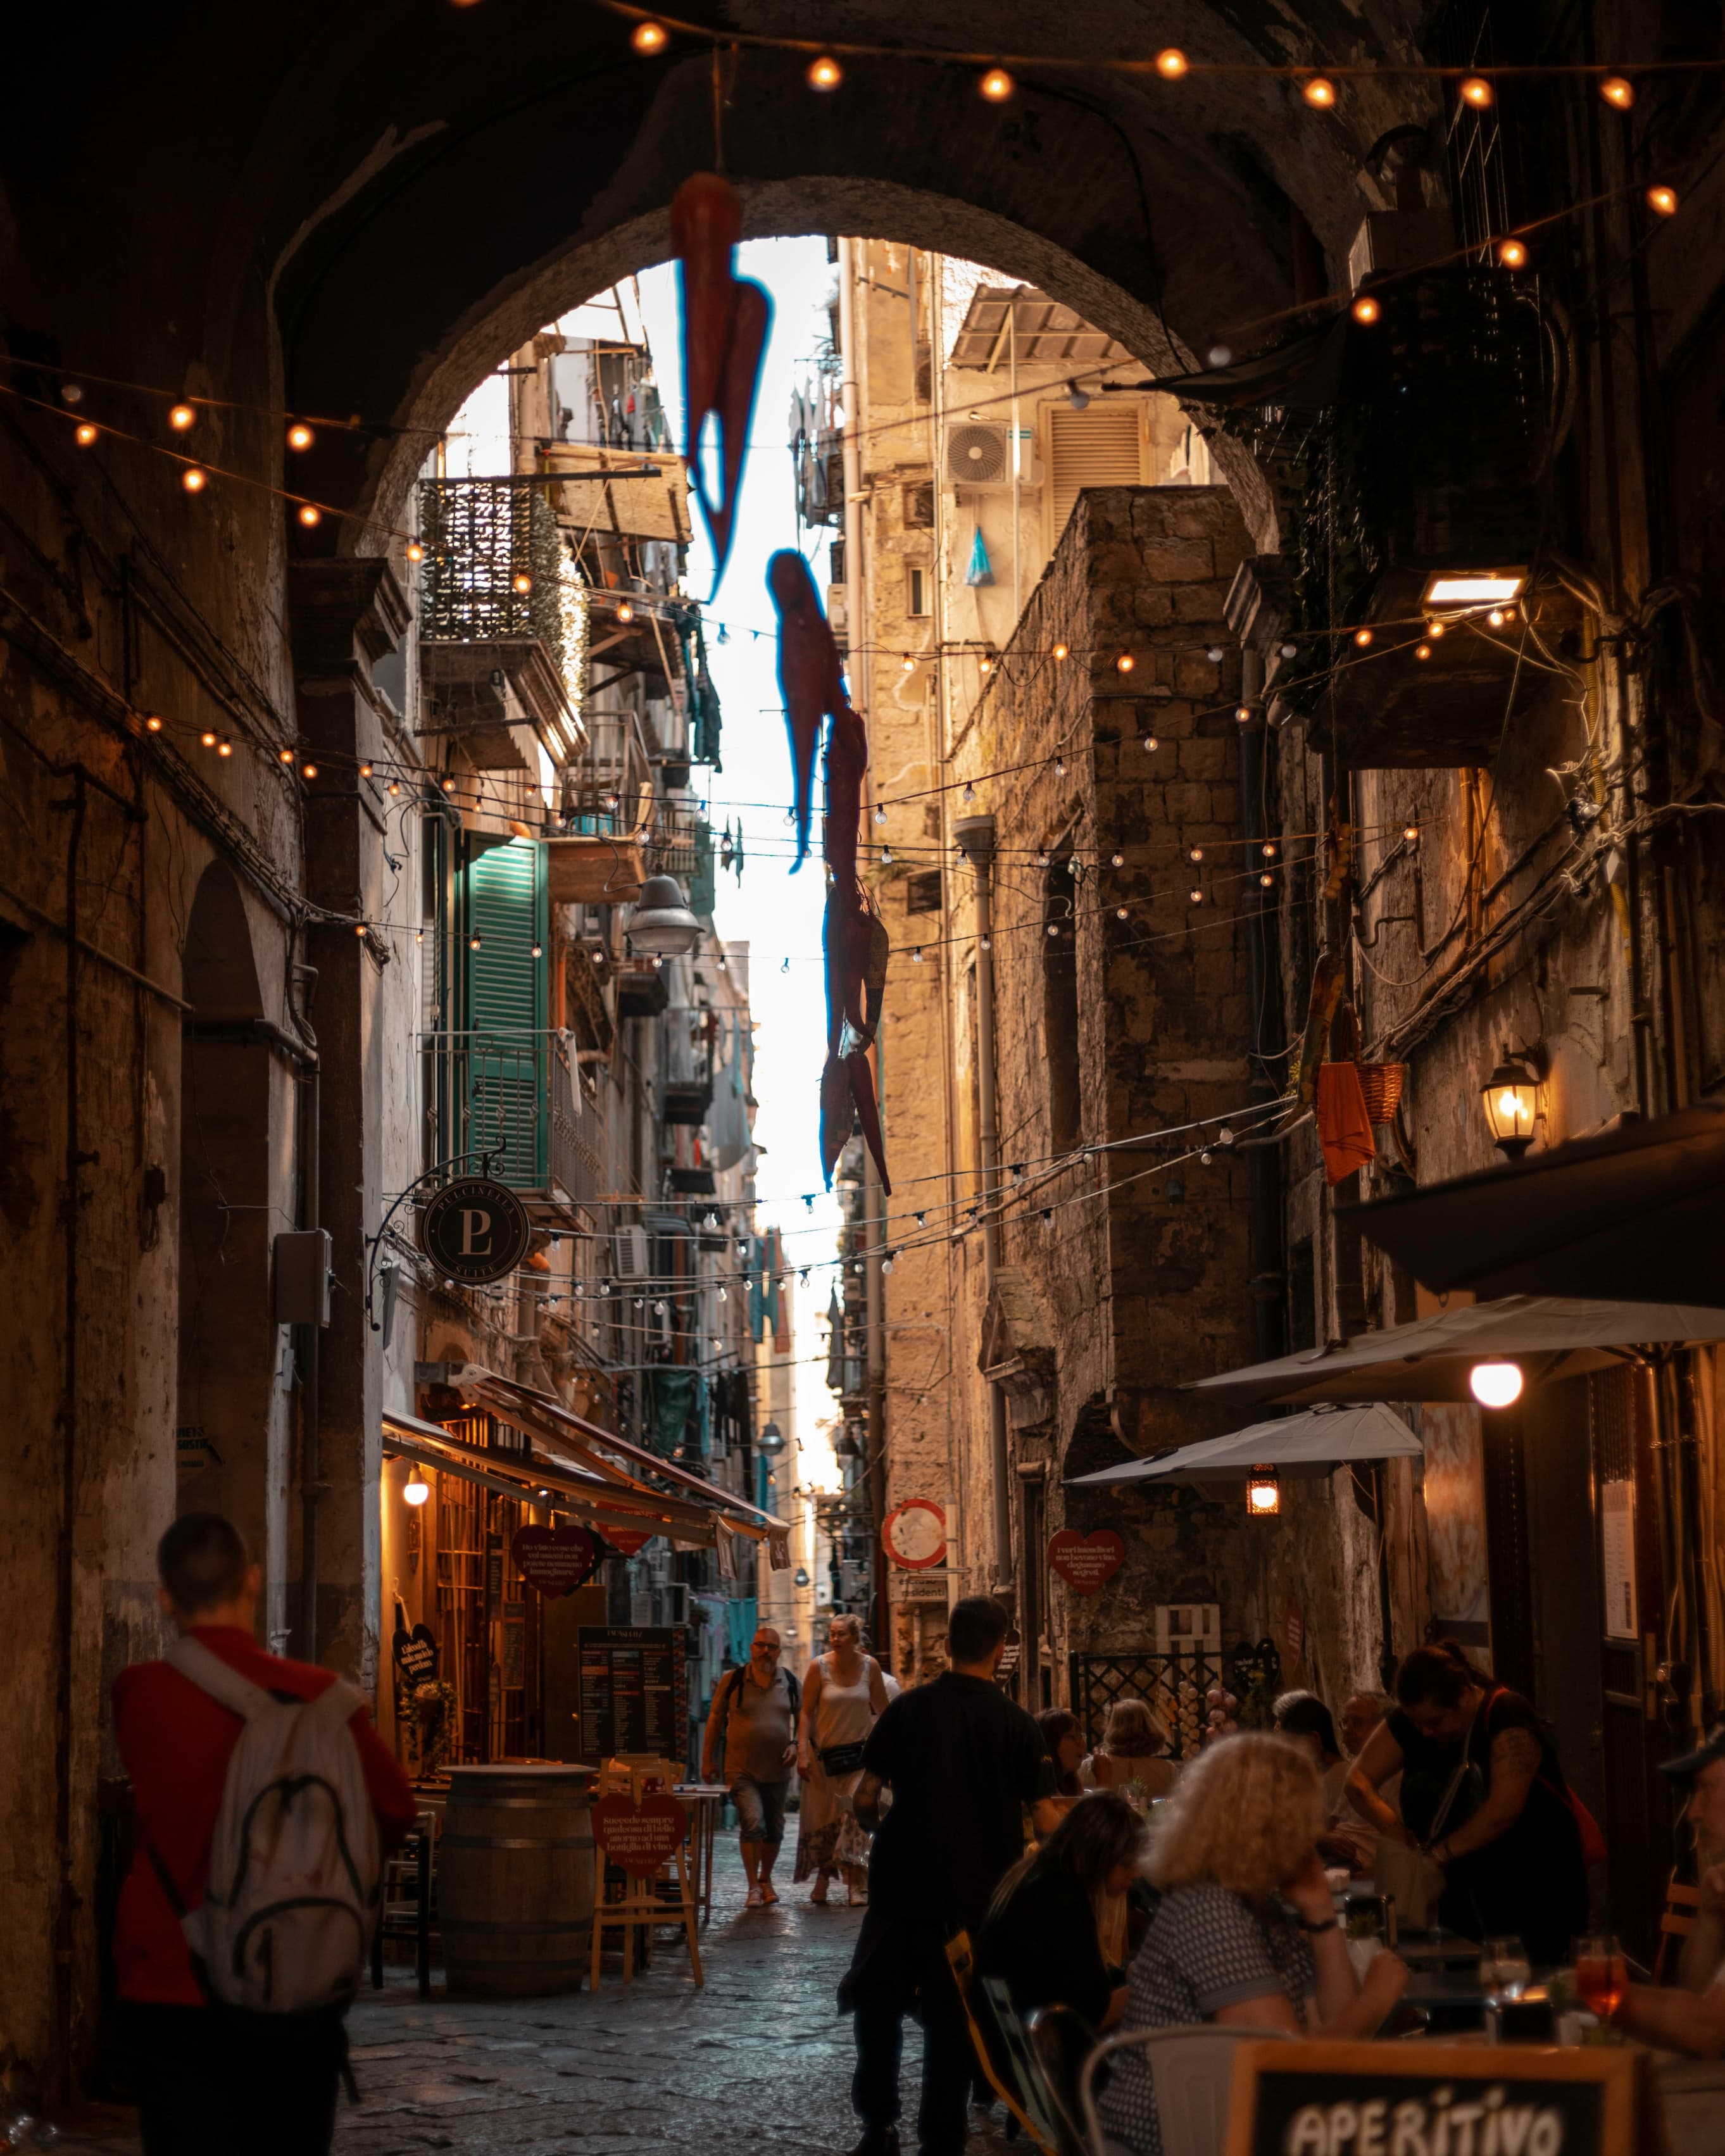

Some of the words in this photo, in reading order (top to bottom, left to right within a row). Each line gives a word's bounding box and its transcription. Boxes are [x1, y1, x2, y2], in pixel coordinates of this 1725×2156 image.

[438, 1185, 515, 1215] PULCINELLA
[455, 1265, 496, 1277] SUITE
[901, 1587, 945, 1596] residenti
[603, 1824, 643, 1834] qualcosa
[643, 1824, 653, 1833] di
[653, 1824, 675, 1833] bello
[642, 1842, 651, 1851] di
